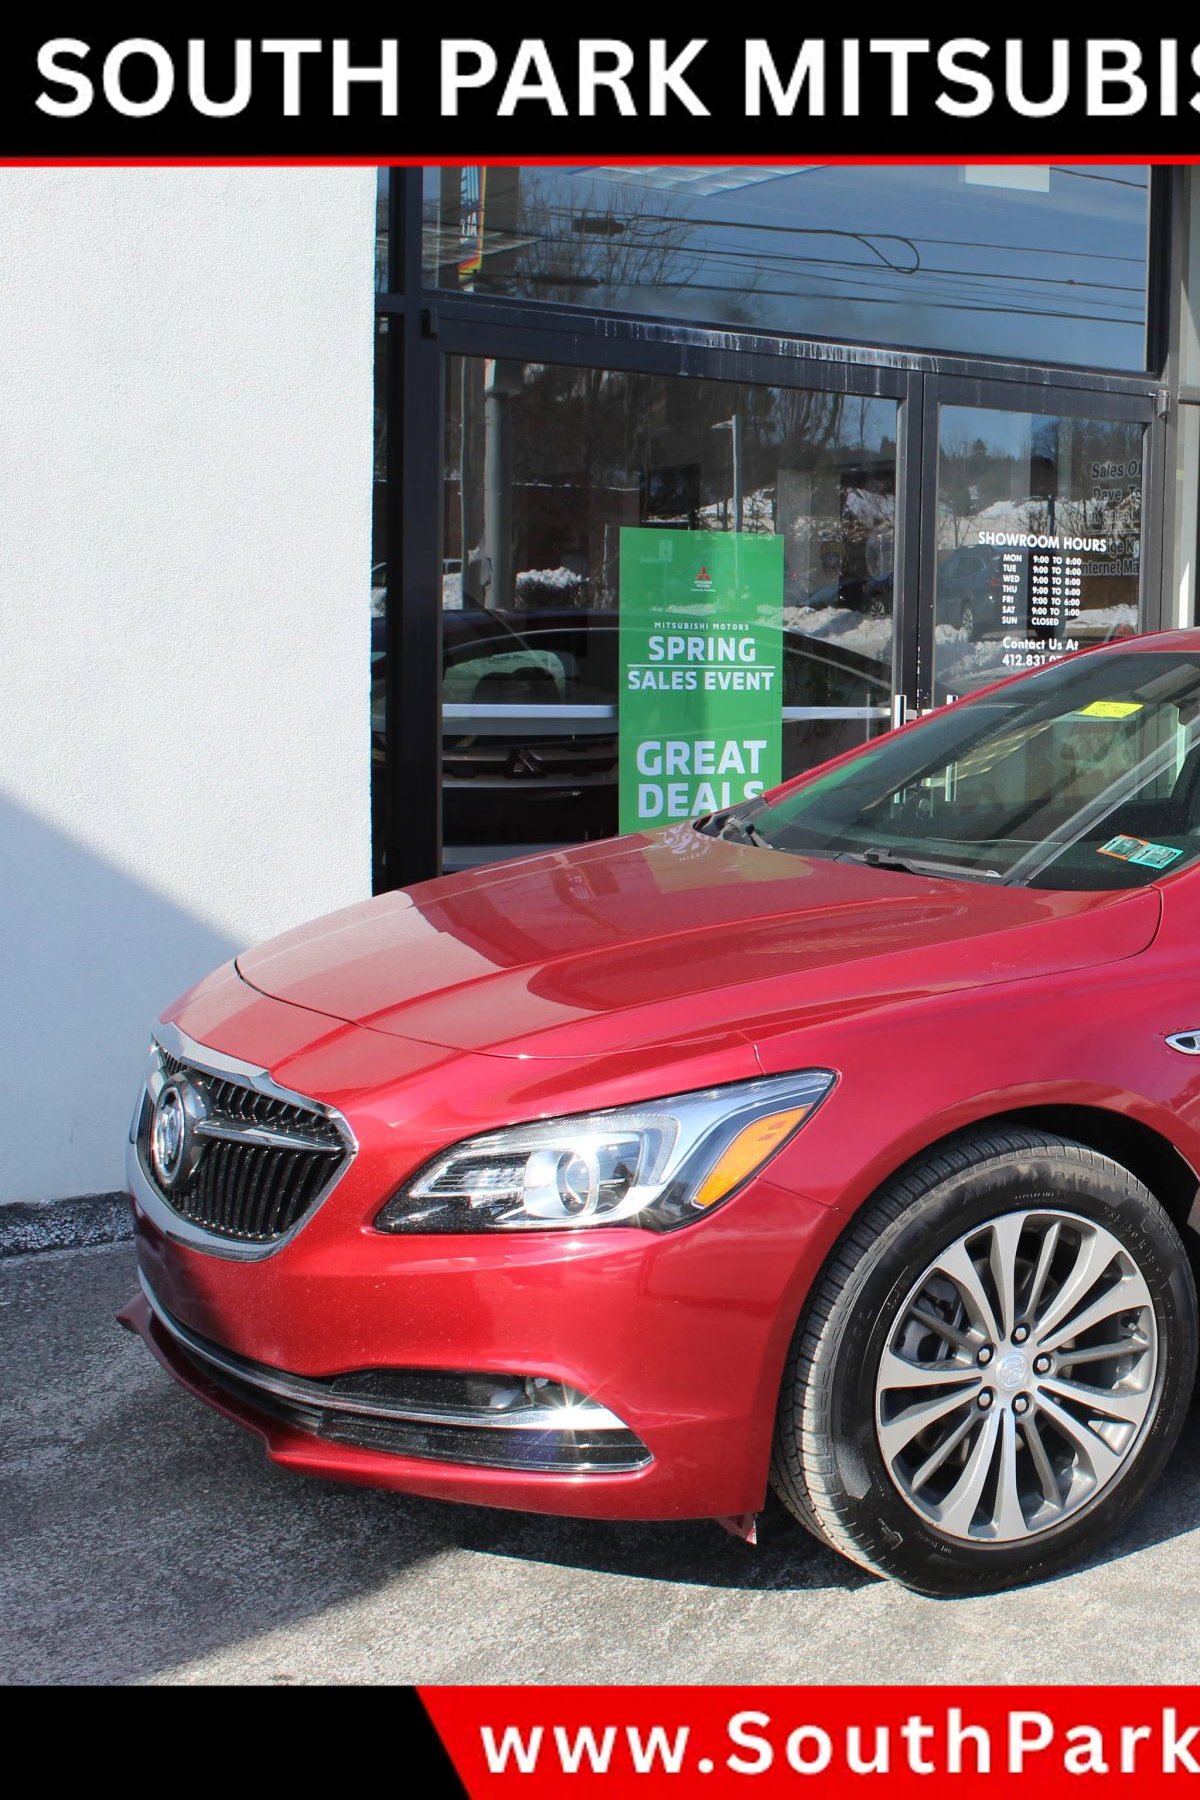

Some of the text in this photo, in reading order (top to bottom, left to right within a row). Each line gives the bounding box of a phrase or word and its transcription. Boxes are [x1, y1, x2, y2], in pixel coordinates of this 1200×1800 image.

[1092, 462, 1124, 479] Sales
[978, 531, 1107, 552] SHOWROOM HOURS
[1003, 554, 1082, 566] MON 9:00 TO 8:00
[1003, 564, 1081, 576] TUE 9:00 TO 8:00
[1081, 559, 1121, 576] nternet
[1003, 575, 1081, 586] WED 9:00 TO 8:00
[1002, 585, 1081, 597] THU 9:00 TO 8:00
[1032, 597, 1048, 605] 9:00
[1051, 598, 1061, 606] TO
[1064, 598, 1080, 607] 6:00
[1002, 606, 1080, 617] SAT 9:00 TO 5:00
[654, 621, 750, 631] MITSUBISHI MOTORS
[1002, 616, 1059, 626] SUN CLOSED
[648, 636, 756, 662] SPRING
[1003, 636, 1079, 651] Contact Us At
[627, 670, 775, 691] SALES EVENT
[636, 740, 767, 776] GREAT
